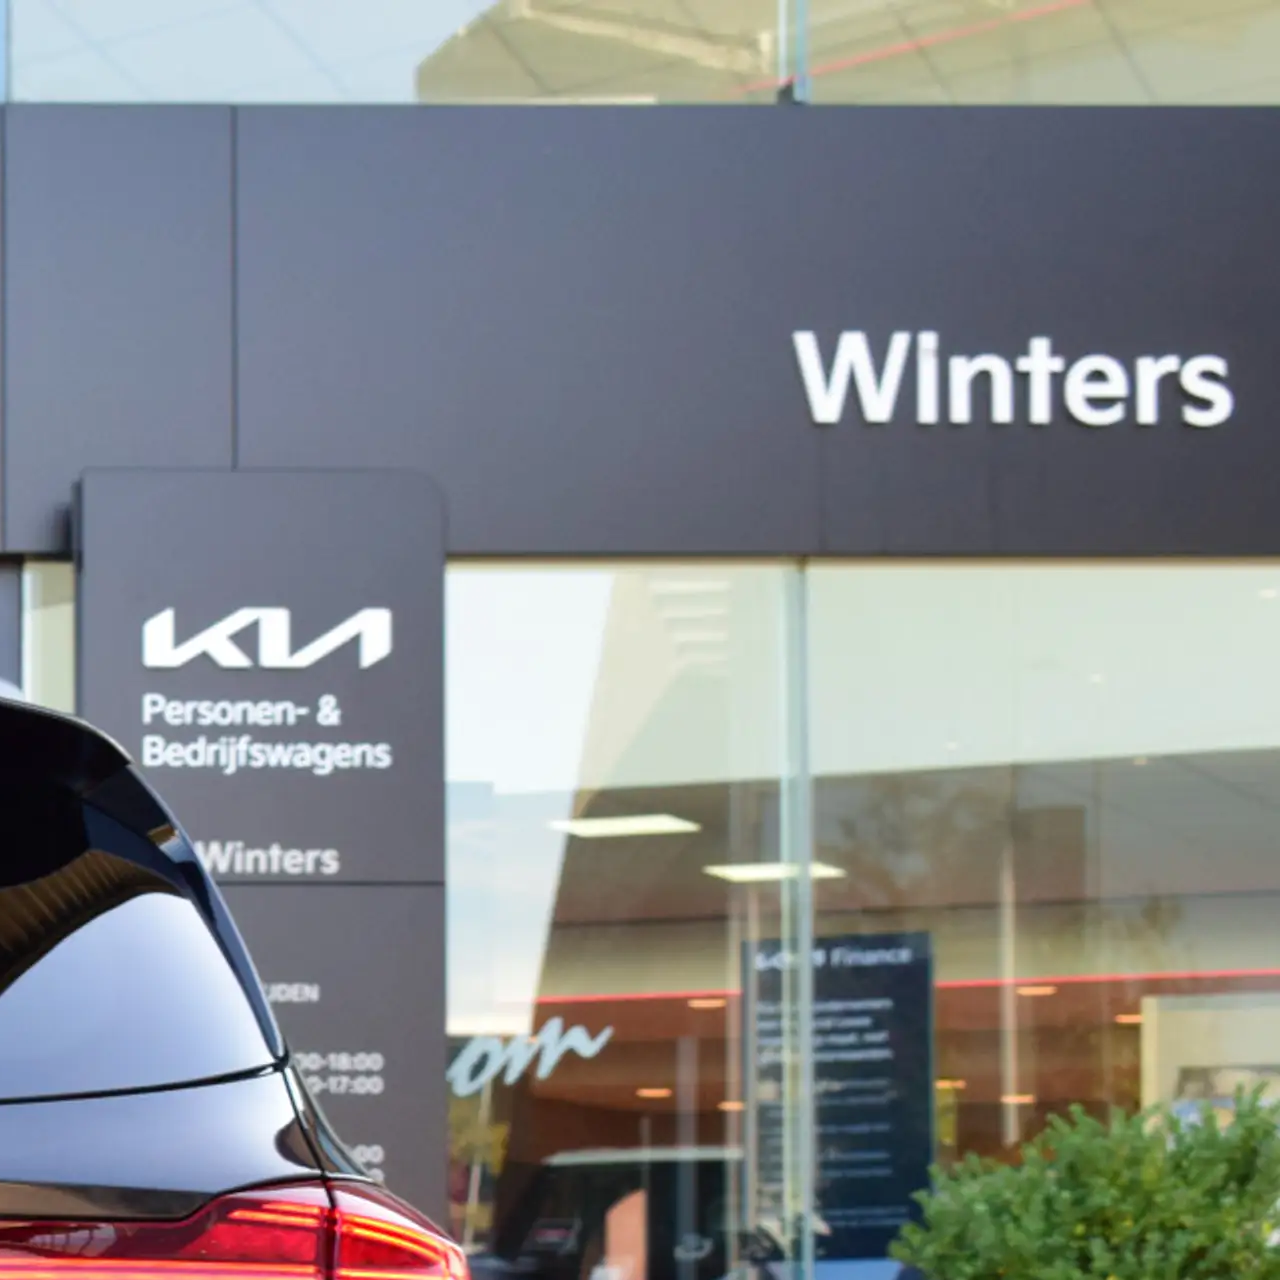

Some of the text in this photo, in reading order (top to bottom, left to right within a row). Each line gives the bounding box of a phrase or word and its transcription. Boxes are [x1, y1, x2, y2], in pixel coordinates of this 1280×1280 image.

[792, 330, 1235, 427] Winters
[142, 607, 392, 669] KIA
[142, 693, 341, 726] Personen- &
[142, 735, 392, 776] Bedrijfswagens
[193, 841, 340, 874] Winters
